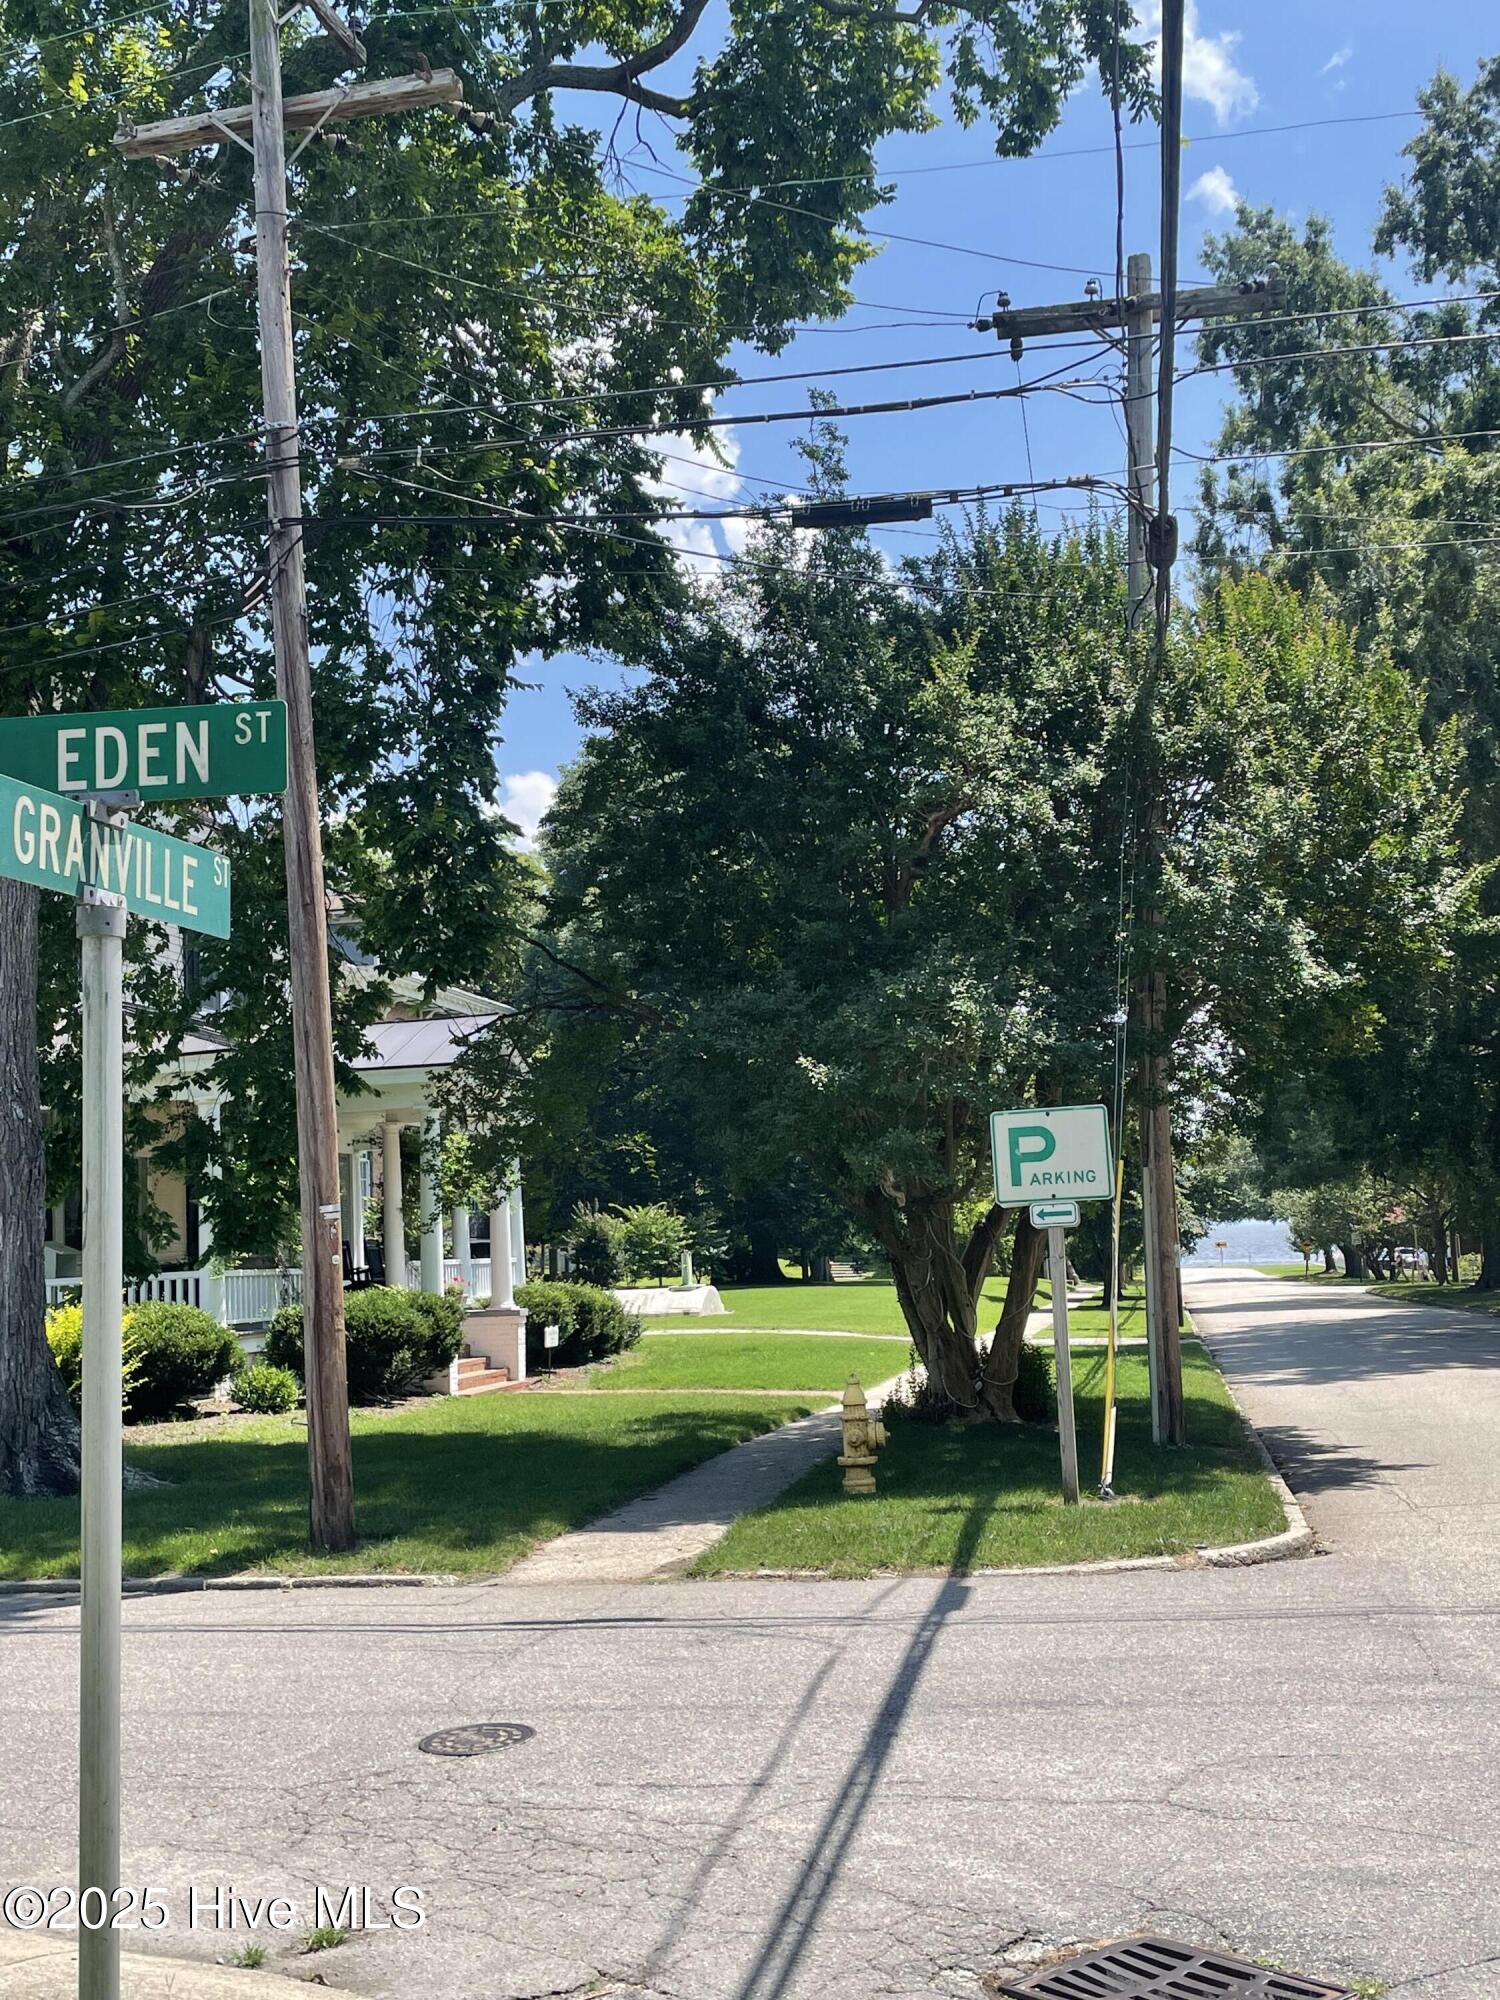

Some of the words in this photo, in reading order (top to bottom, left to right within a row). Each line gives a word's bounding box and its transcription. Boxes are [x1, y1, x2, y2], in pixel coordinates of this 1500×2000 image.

[57, 720, 209, 791] EDEN
[234, 711, 272, 744] ST
[14, 795, 198, 916] GRANVILLE
[213, 856, 230, 888] ST
[1008, 1126, 1096, 1187] PARKING
